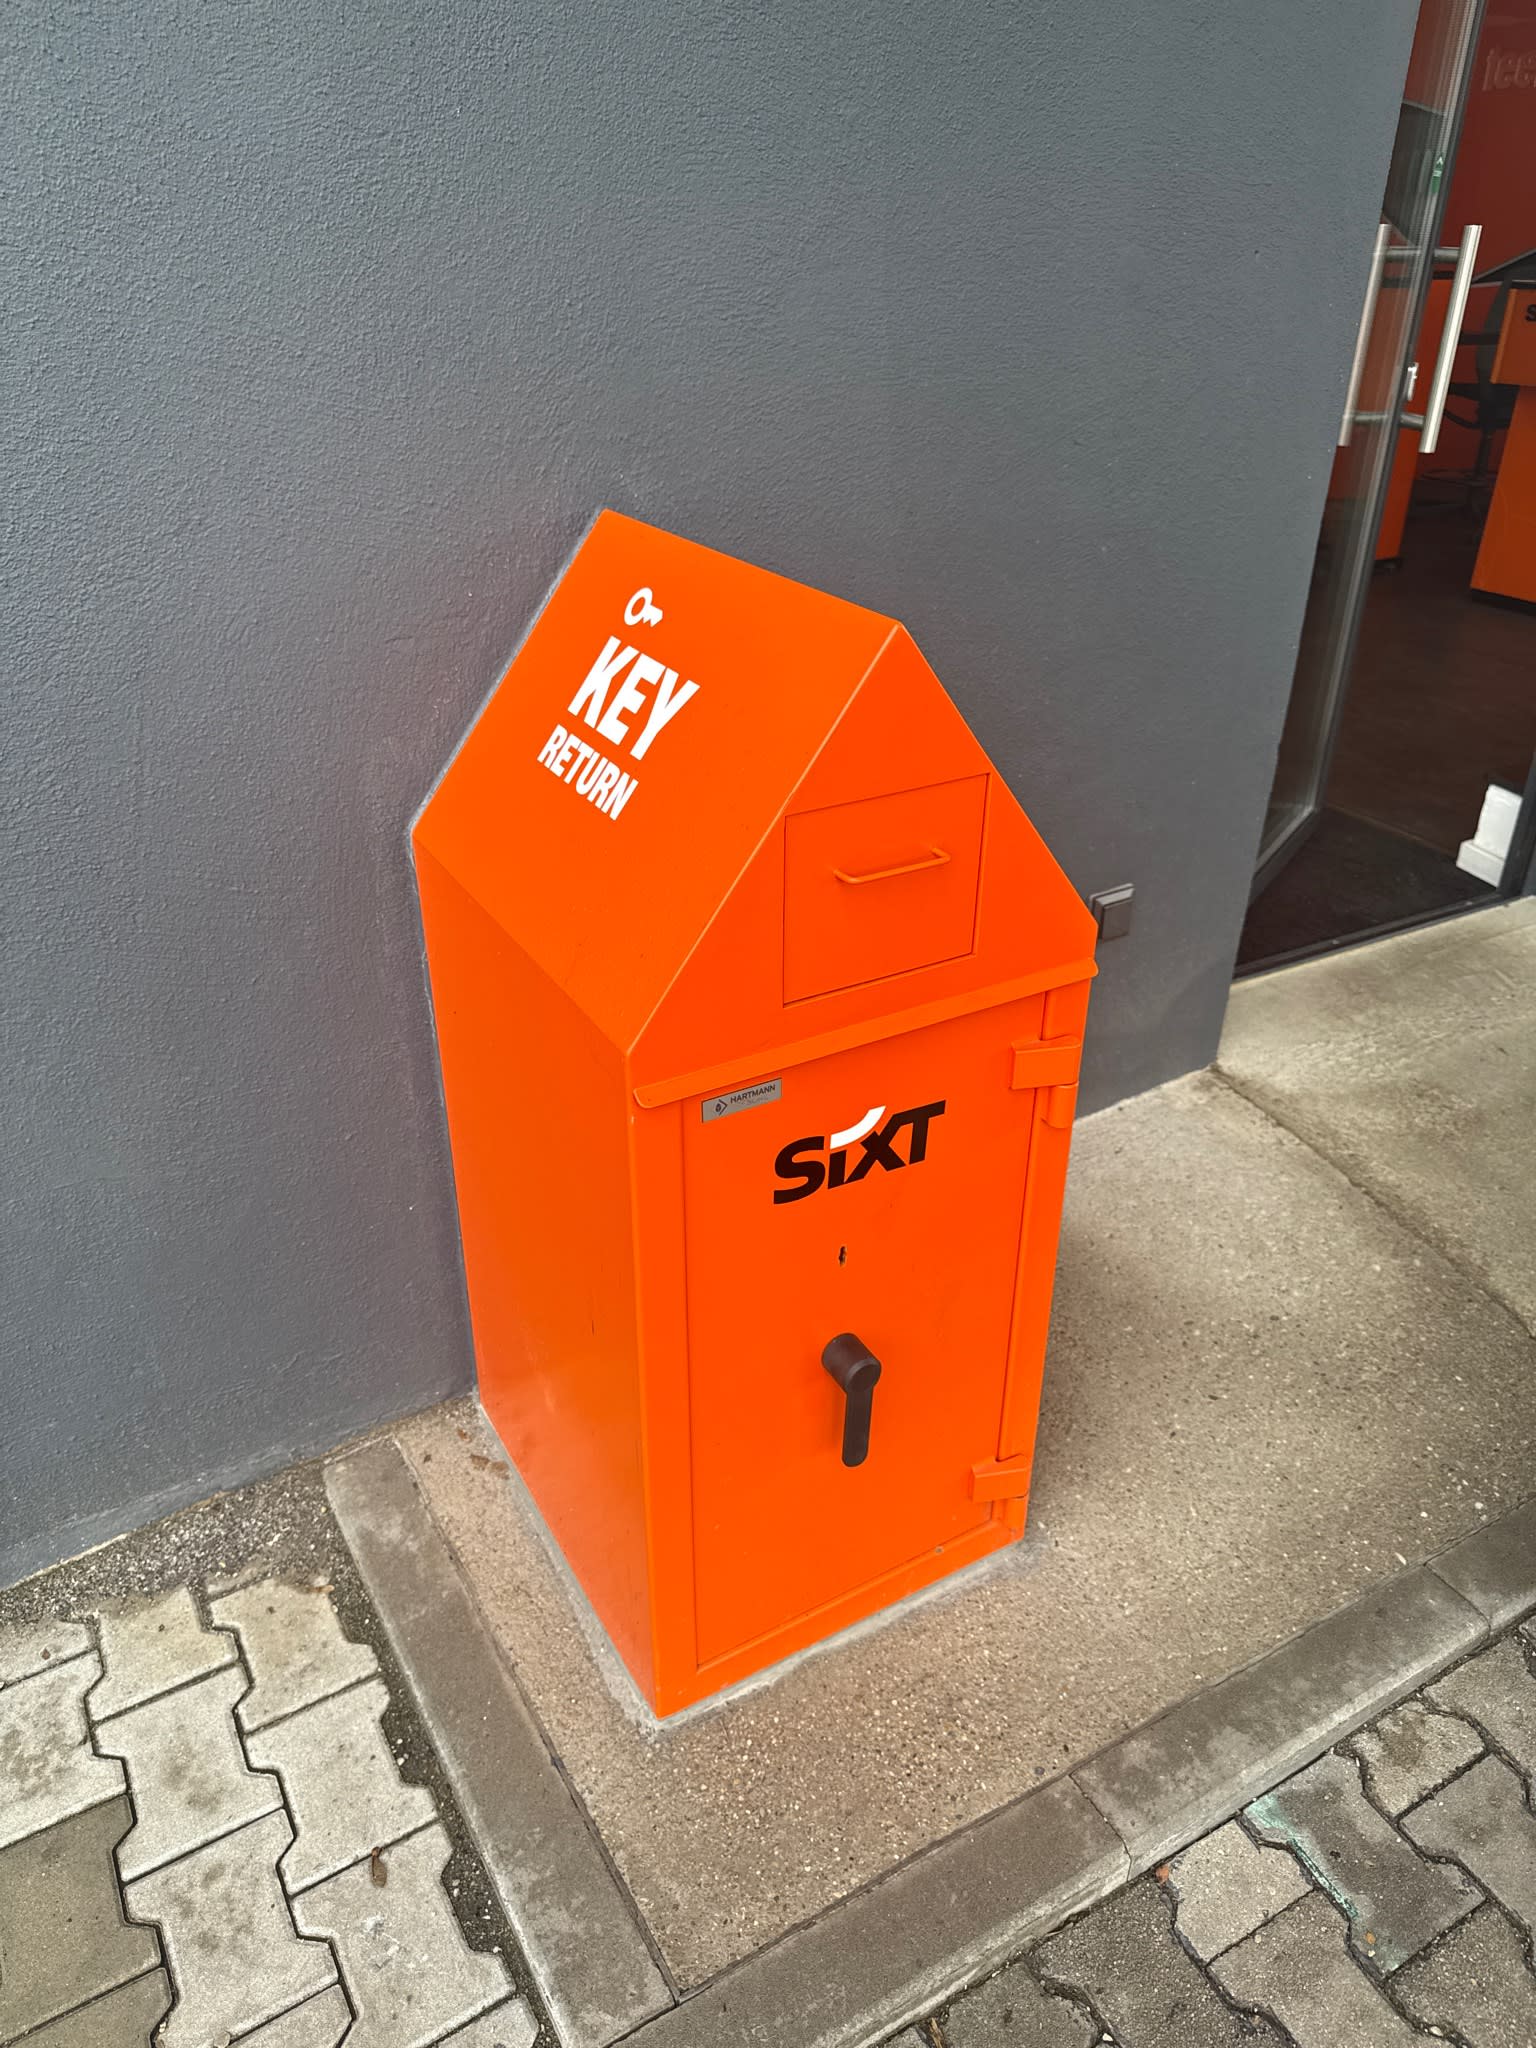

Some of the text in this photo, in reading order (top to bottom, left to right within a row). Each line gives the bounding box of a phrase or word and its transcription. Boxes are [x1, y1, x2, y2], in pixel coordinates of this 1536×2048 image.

[567, 635, 700, 761] KEY
[537, 723, 639, 821] RETURN
[730, 1084, 776, 1104] HARTMANN
